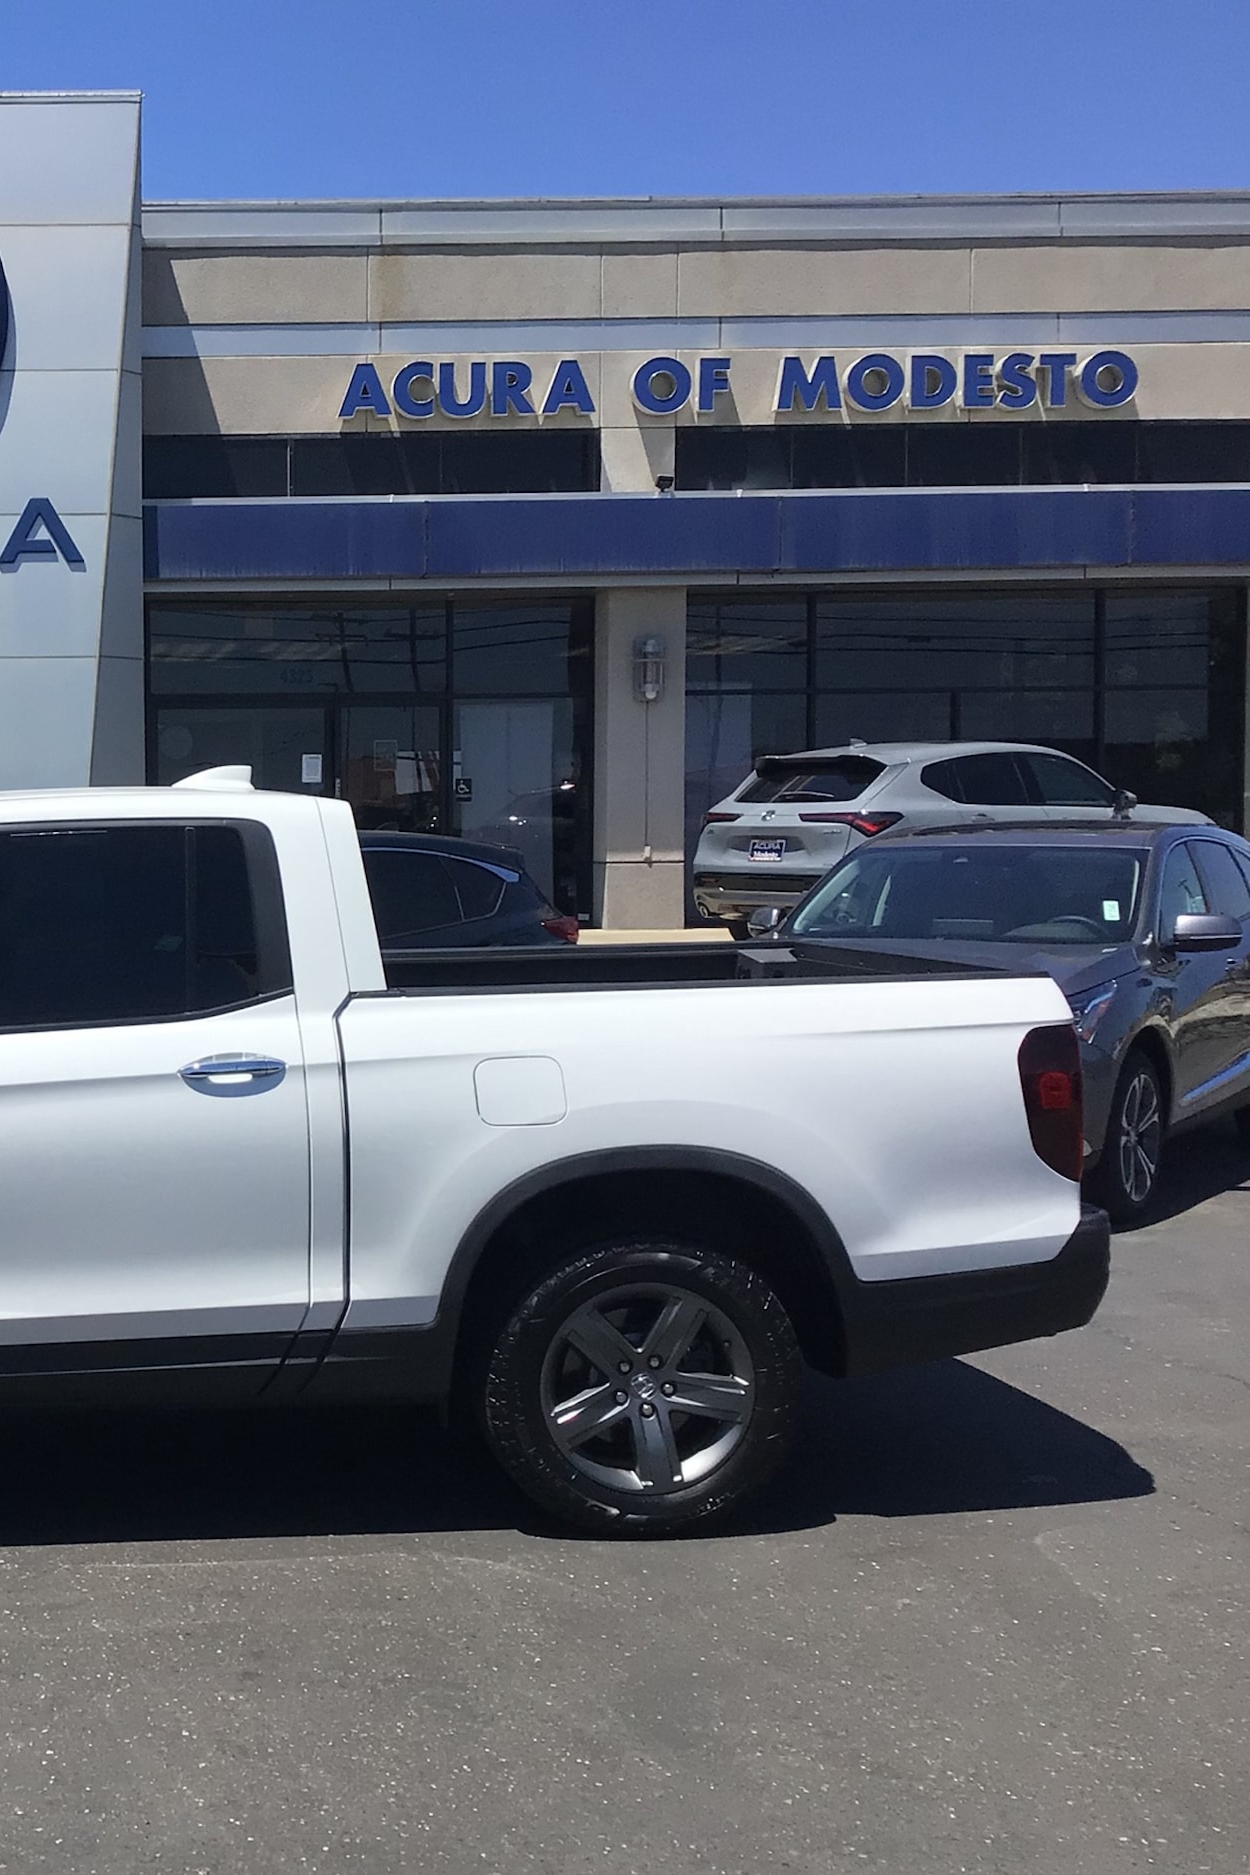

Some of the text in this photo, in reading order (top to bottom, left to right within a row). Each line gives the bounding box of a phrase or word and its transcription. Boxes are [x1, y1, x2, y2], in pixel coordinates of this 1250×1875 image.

[338, 350, 1140, 420] ACURA OF MODESTO
